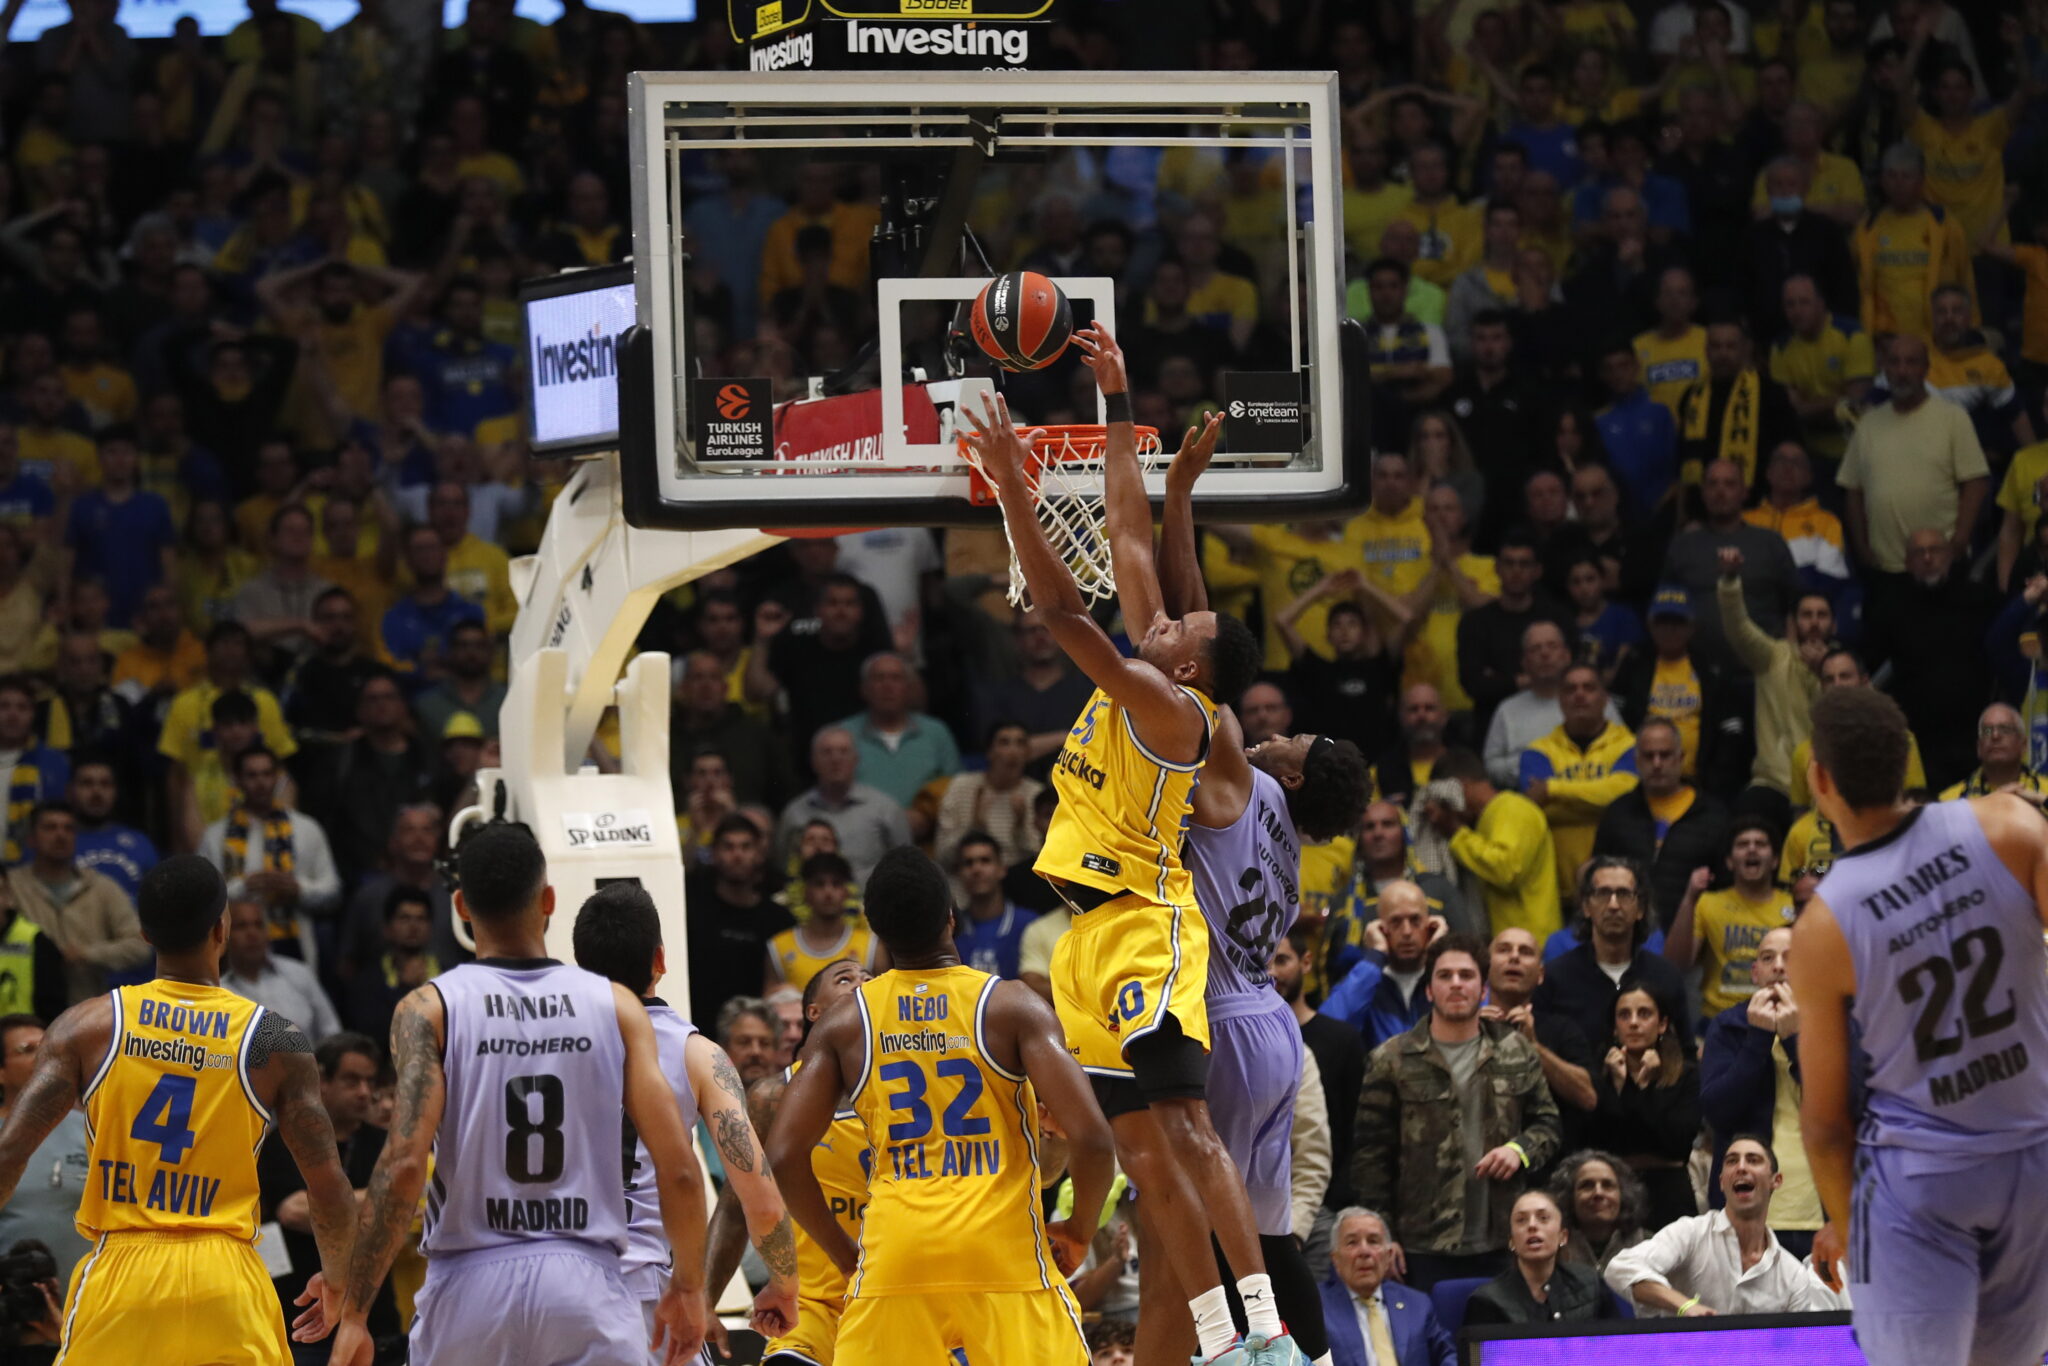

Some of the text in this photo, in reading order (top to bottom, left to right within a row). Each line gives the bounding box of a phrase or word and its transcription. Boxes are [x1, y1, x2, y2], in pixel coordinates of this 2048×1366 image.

[750, 31, 813, 71] Investing
[847, 20, 1029, 64] Investing
[535, 323, 622, 387] Investin
[707, 422, 762, 433] TURKISH
[1247, 406, 1299, 417] oneteam
[706, 446, 764, 457] EuroLeague
[707, 434, 763, 445] AIRLINES
[852, 432, 884, 461] AIRLI
[568, 825, 651, 846] SPALDING
[1860, 843, 1971, 921] TAVARES
[1888, 888, 1987, 955] AUTOHERO
[484, 993, 576, 1022] HANGA
[897, 994, 948, 1022] NEBO
[1896, 925, 2017, 1064] 22
[138, 998, 231, 1040] BROWN
[124, 1031, 233, 1072] Investing.com
[476, 1036, 592, 1057] AUTOHERO
[879, 1028, 971, 1056] Investing.com
[1928, 1041, 2029, 1107] MADRID
[130, 1073, 197, 1165] 4
[879, 1057, 992, 1142] 32
[505, 1073, 565, 1184] 8
[887, 1143, 933, 1181] TEL
[941, 1139, 1000, 1178] AVIV
[98, 1159, 221, 1217] TEL AVIV
[486, 1196, 589, 1232] MADRID
